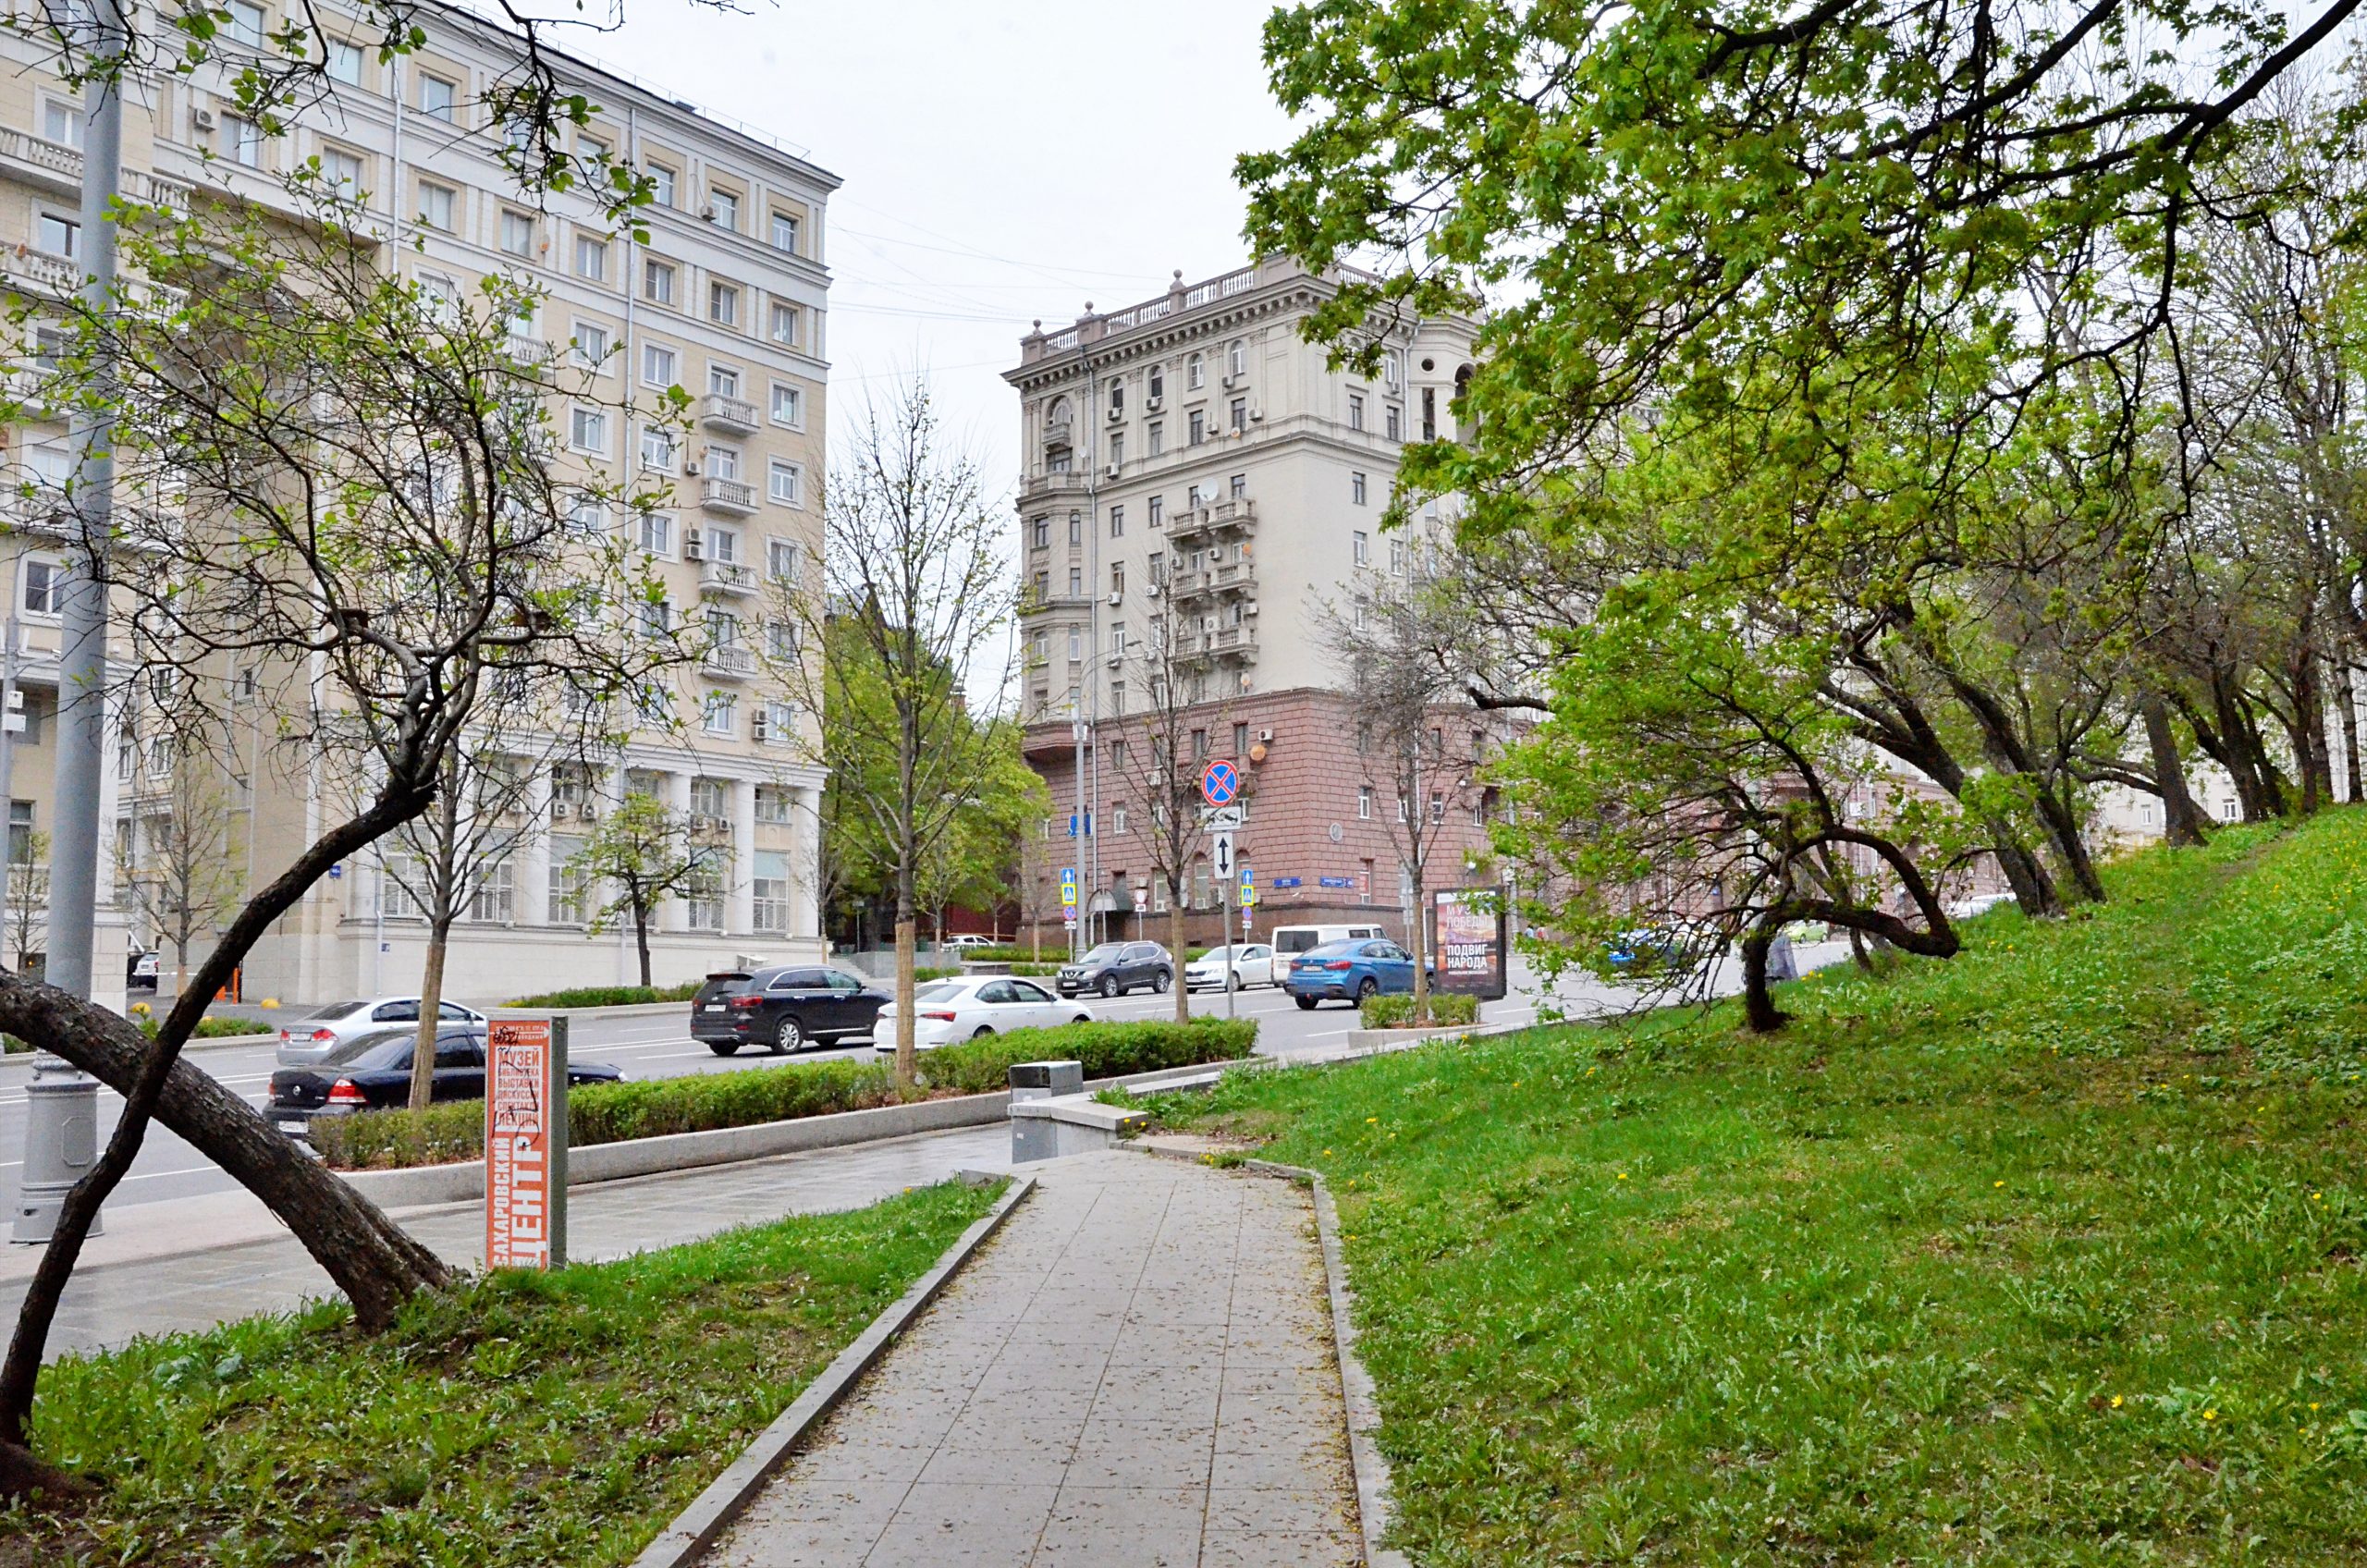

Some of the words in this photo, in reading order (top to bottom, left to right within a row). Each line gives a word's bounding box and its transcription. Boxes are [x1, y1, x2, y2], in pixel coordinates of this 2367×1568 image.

[1446, 916, 1488, 928] ПОБЕДЫ
[1447, 944, 1488, 957] ПОДВИГ
[1447, 957, 1488, 969] НАРОДА
[498, 1047, 539, 1066] МУЗЕЙ
[498, 1112, 539, 1128] ЛЕКЦИИ
[492, 1137, 510, 1267] САХАРОВСКИЙ
[511, 1135, 547, 1268] ЦЕНТР
